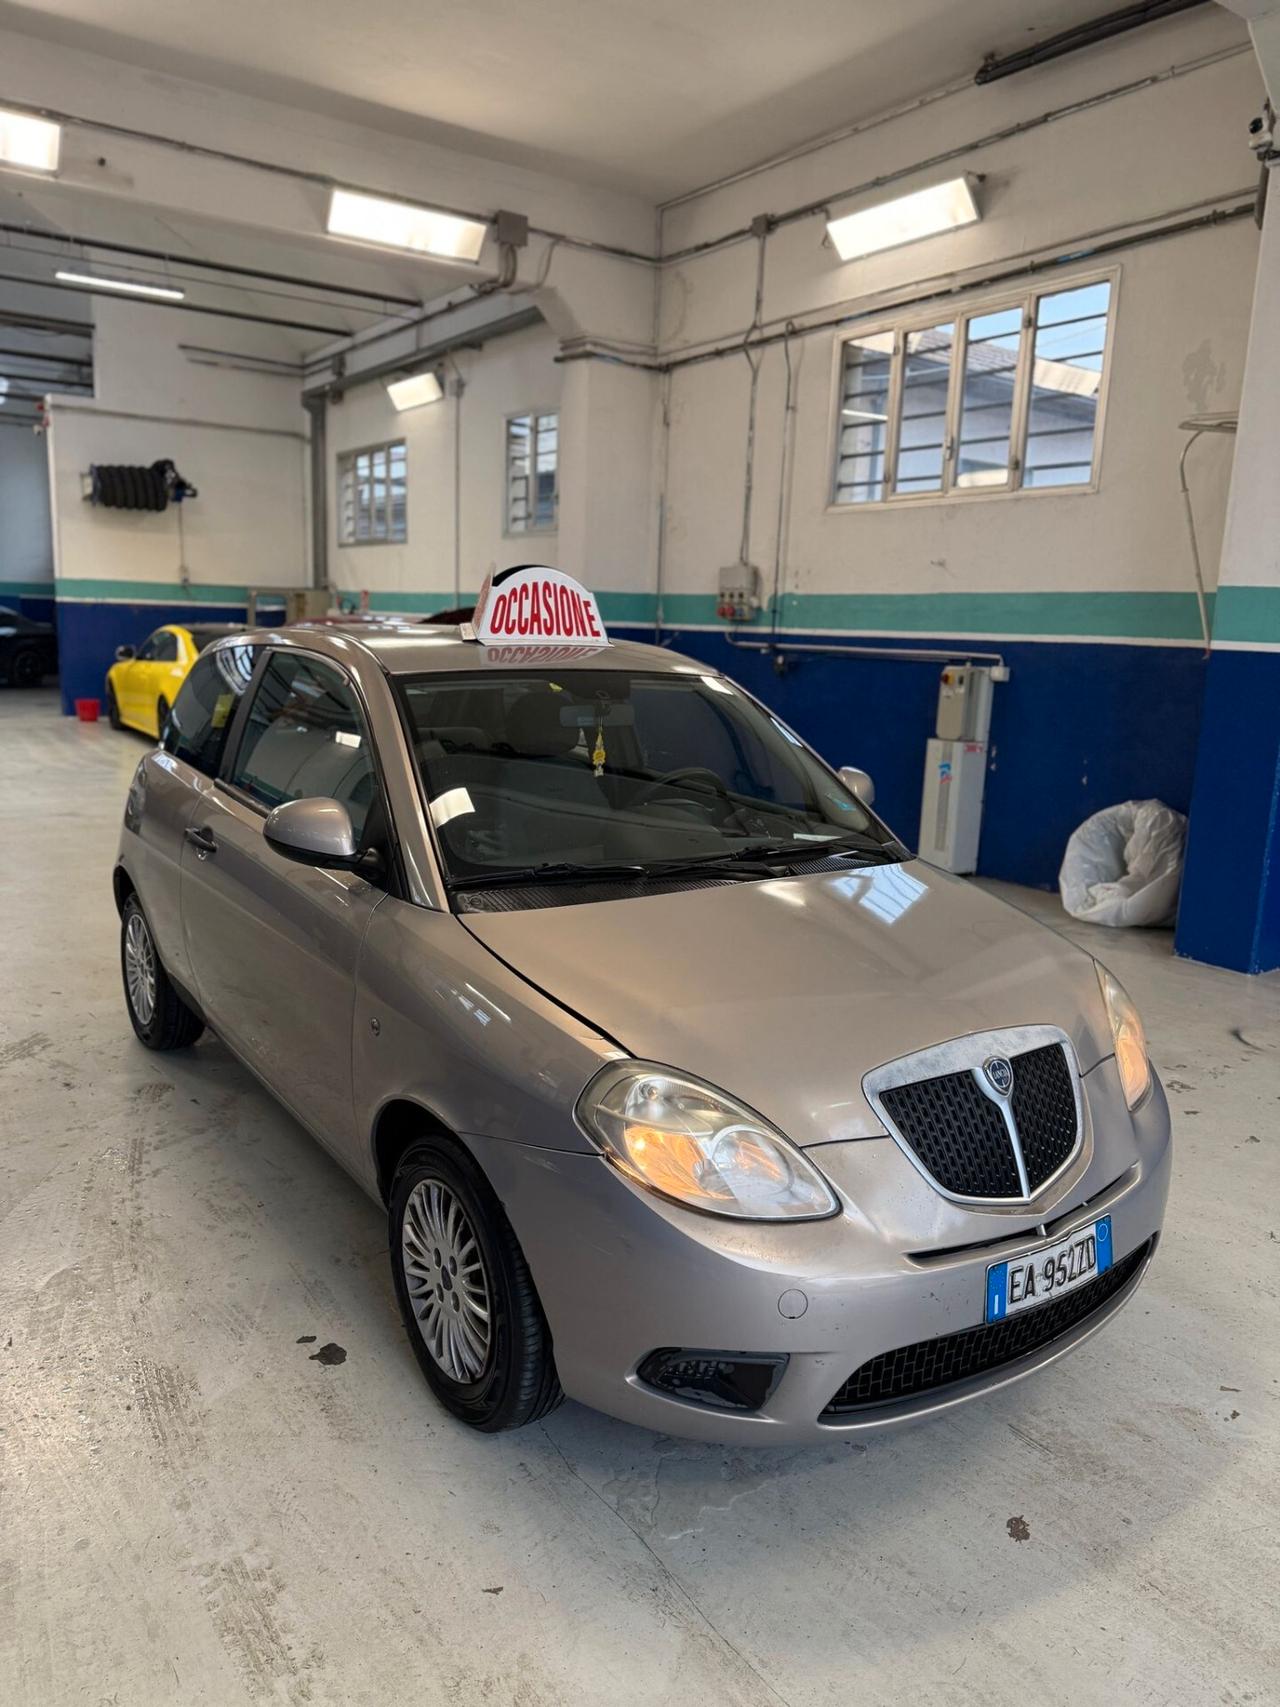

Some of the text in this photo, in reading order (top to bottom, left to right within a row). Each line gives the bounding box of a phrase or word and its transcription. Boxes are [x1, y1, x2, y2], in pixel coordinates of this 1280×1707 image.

[490, 581, 600, 637] OCCASIONE
[1008, 1235, 1096, 1304] EA 952ZD
[994, 1294, 999, 1315] I
